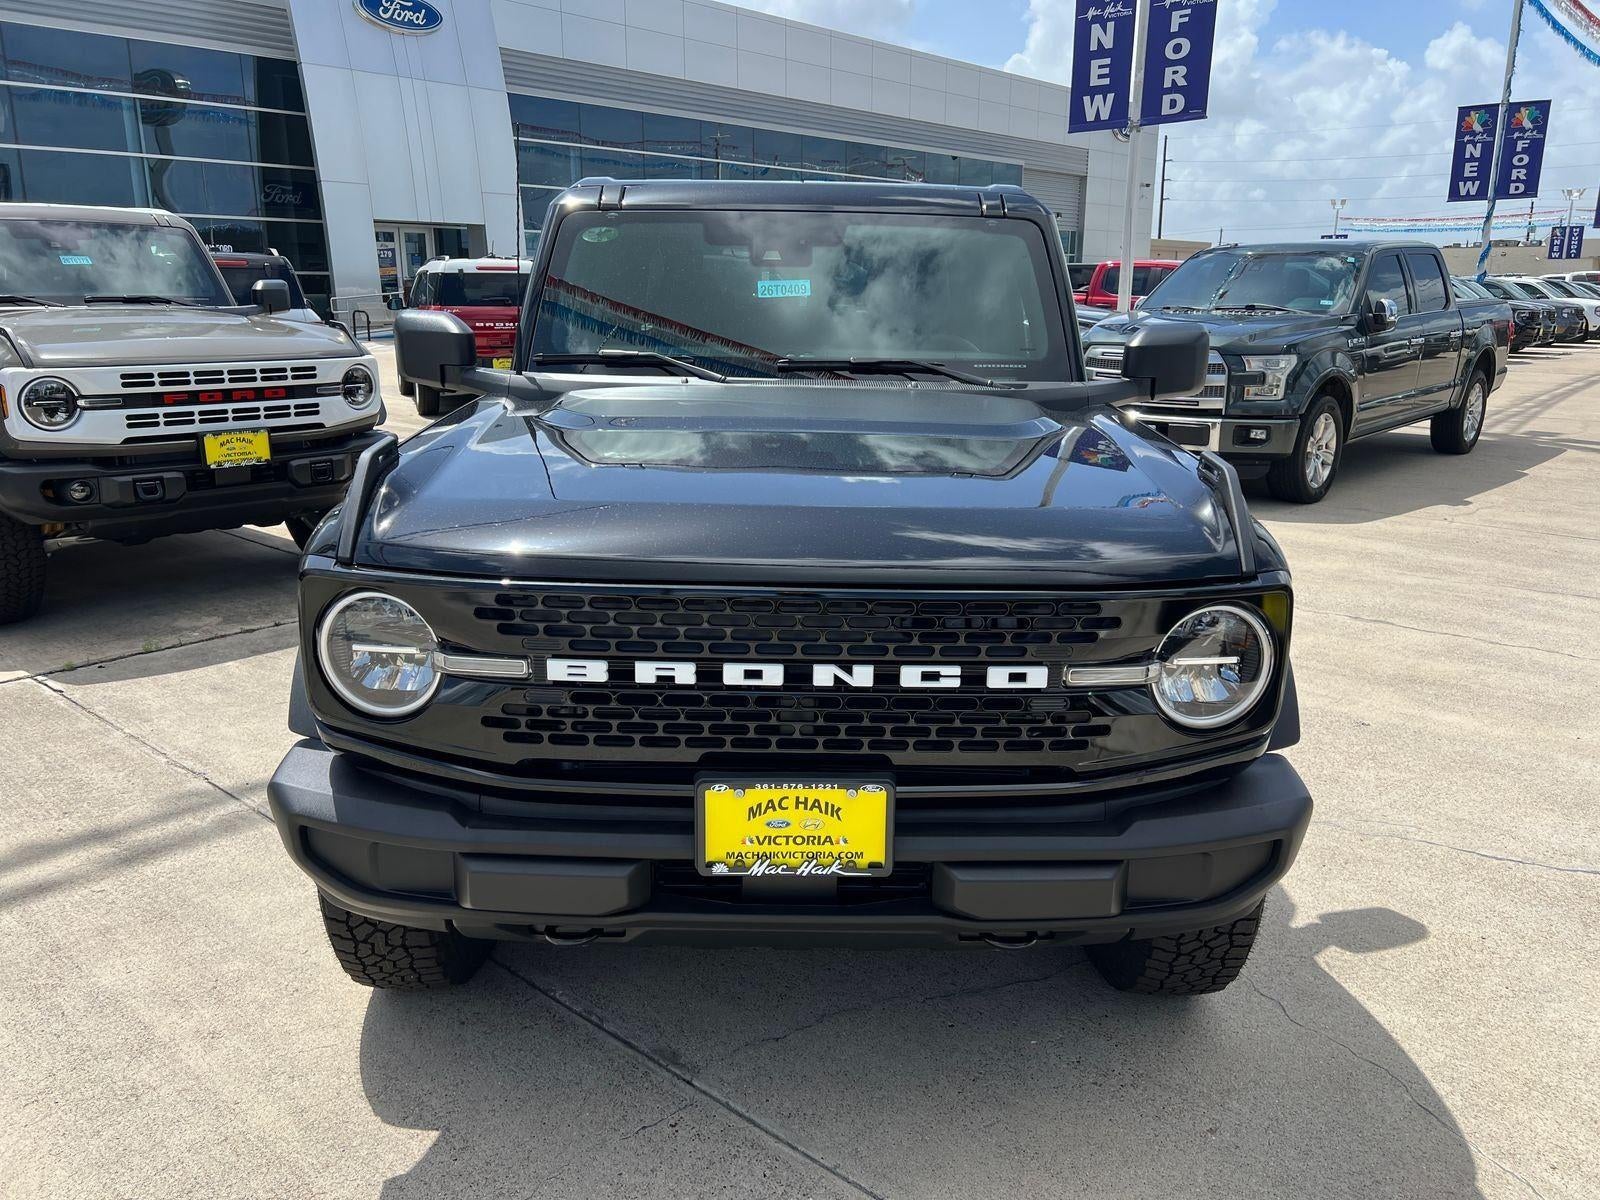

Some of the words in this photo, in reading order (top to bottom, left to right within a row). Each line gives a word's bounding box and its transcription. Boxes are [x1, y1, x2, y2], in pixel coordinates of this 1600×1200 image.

[379, 0, 426, 25] Ford
[1083, 21, 1115, 122] NEW
[1161, 9, 1192, 116] FORD
[1458, 143, 1482, 196] NEW
[1508, 140, 1530, 195] FORD
[1551, 240, 1560, 258] NEW
[1570, 228, 1580, 257] HYUNDAI
[760, 284, 807, 296] 26T0409
[163, 388, 286, 404] FORD
[220, 438, 235, 448] MAC
[236, 436, 254, 445] HAIK
[546, 657, 1049, 689] BRONCO
[747, 796, 789, 822] MAC
[795, 796, 842, 822] HAIK
[755, 835, 834, 846] VICTORIA
[725, 851, 864, 859] MACHAIKVICTORIA.COM
[744, 857, 793, 876] Mac
[796, 857, 853, 876] Haik
